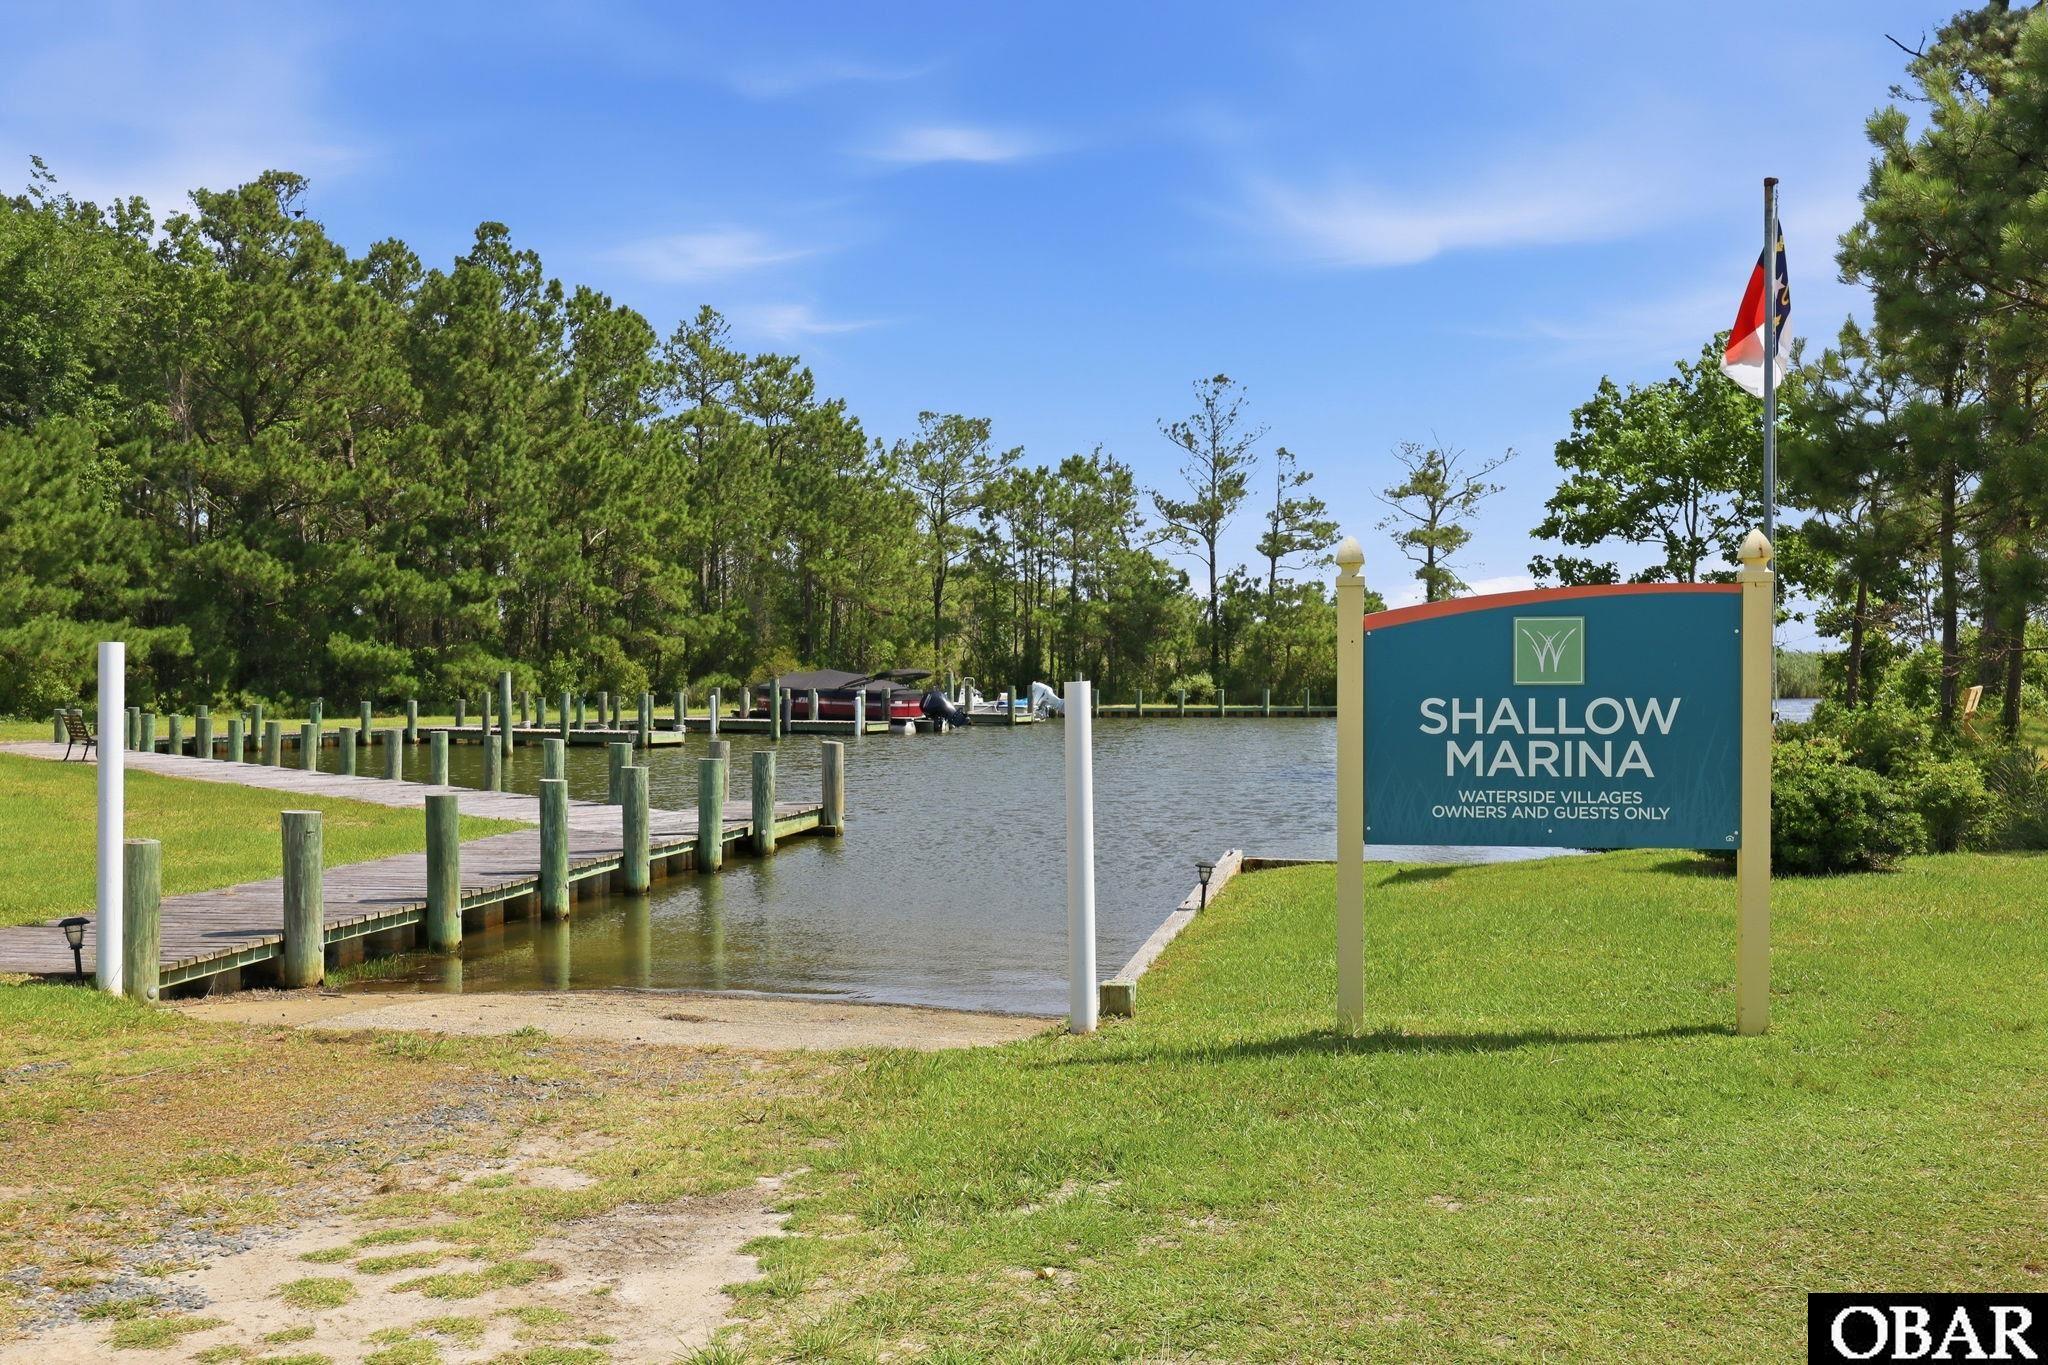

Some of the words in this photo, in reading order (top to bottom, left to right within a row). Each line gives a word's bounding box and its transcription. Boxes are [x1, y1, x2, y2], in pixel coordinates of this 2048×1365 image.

[1419, 697, 1681, 735] SHALLOW
[1446, 740, 1655, 778] MARINA
[1458, 790, 1556, 804] WATERSIDE
[1560, 790, 1643, 805] VILLAGES
[1431, 805, 1507, 819] OWNERS
[1511, 805, 1549, 819] AND
[1553, 806, 1620, 820] GUESTS
[1624, 807, 1671, 820] ONLY
